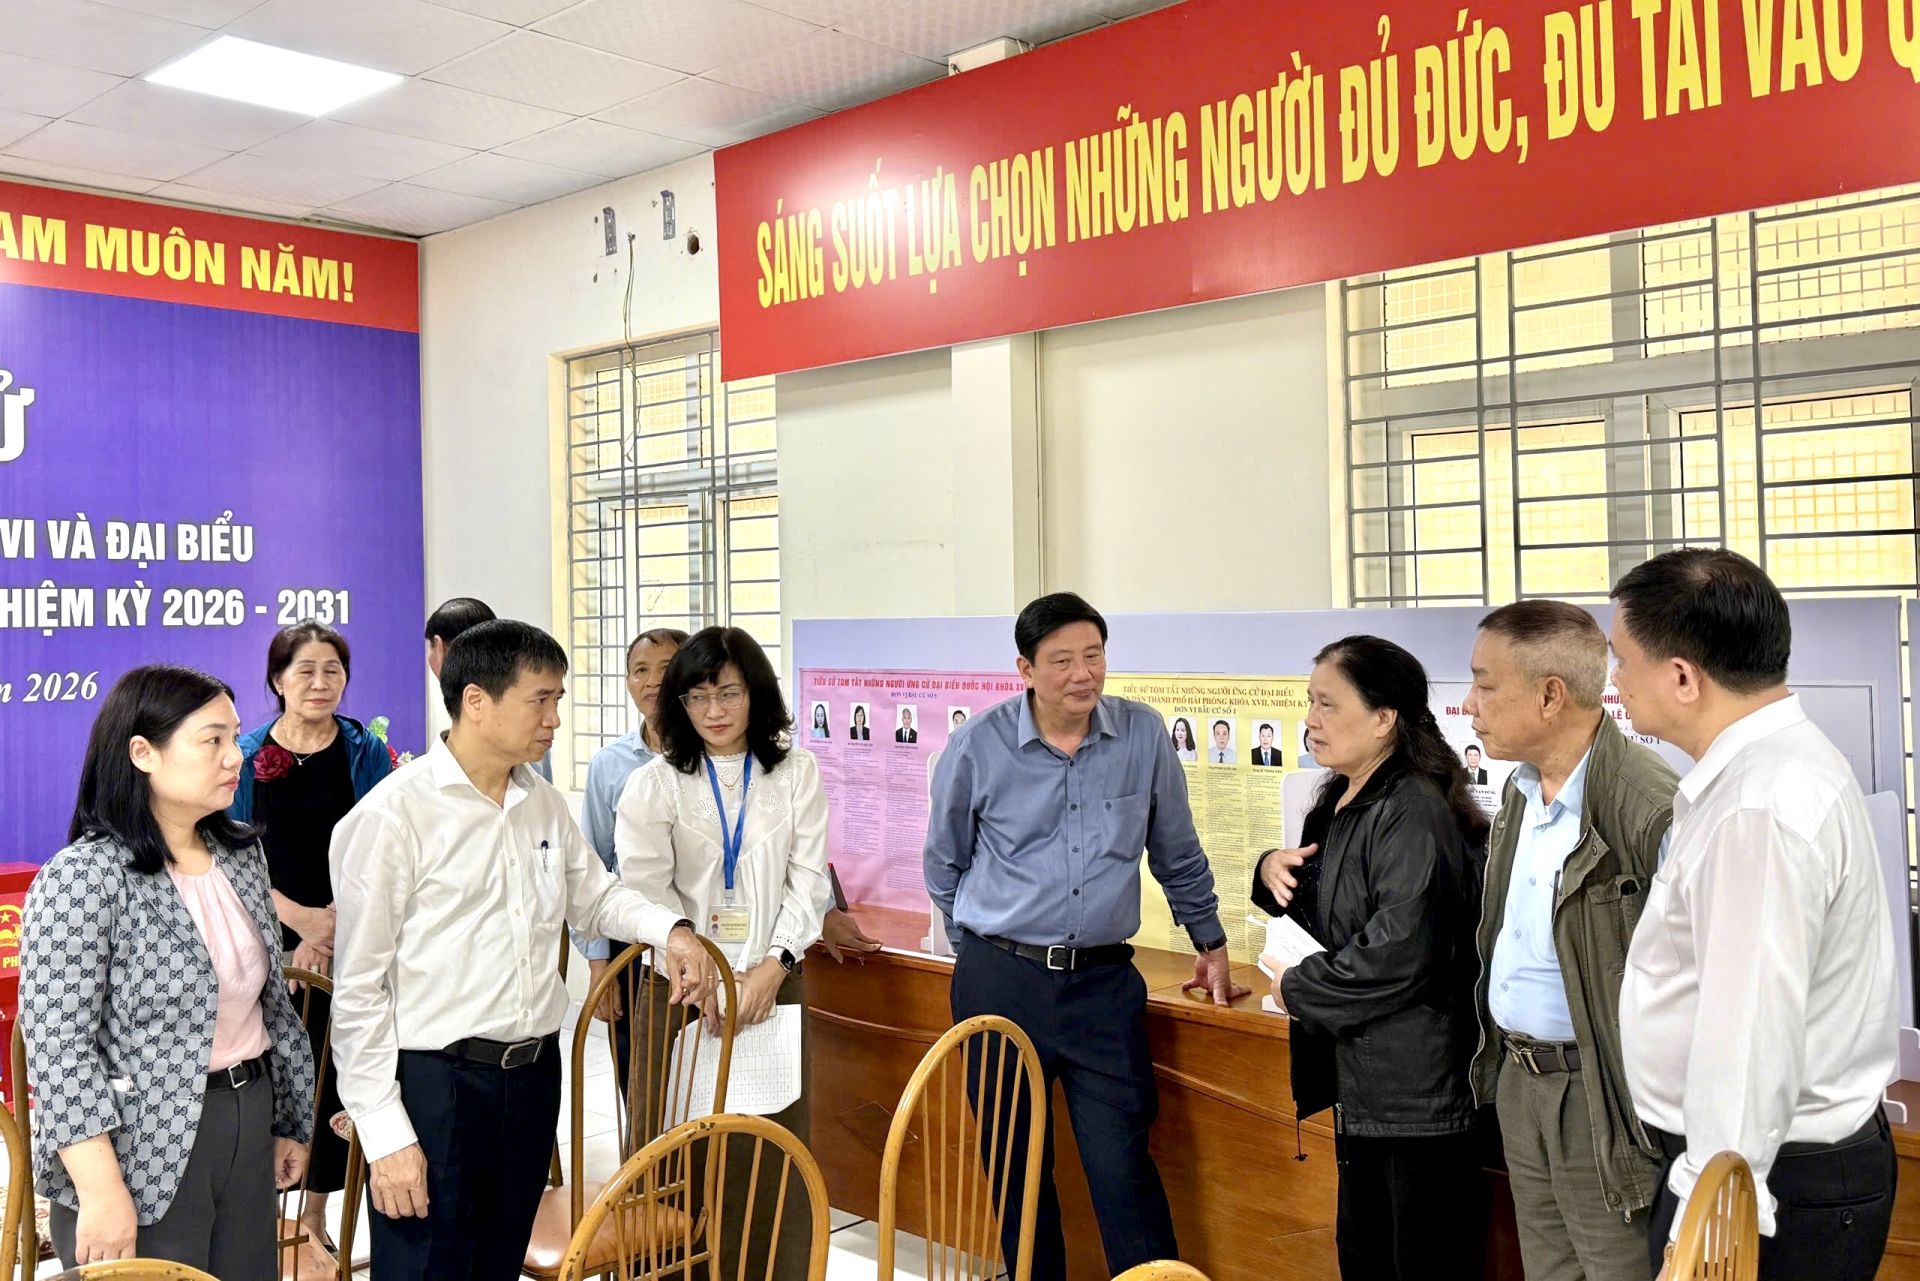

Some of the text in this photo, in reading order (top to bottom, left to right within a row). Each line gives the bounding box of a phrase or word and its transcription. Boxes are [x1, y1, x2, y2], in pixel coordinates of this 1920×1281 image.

[756, 199, 824, 309] SÁNG
[831, 157, 898, 293] SUỐT
[906, 166, 962, 295] LỰA
[969, 147, 1056, 277] CHỌN
[1065, 103, 1188, 243] NHỮNG
[1200, 51, 1326, 213] NGƯỜI
[1339, 14, 1400, 184] ĐỦ
[1413, 9, 1529, 168] ĐỨC,
[85, 223, 225, 286] MUÔN
[241, 243, 354, 303] NĂM!
[47, 512, 96, 559] VÀ
[106, 522, 166, 568] ĐẠI
[177, 510, 254, 562] BIỂU
[0, 580, 349, 636] HIỆM KỲ 2026 - 2031
[22, 671, 100, 702] 2026
